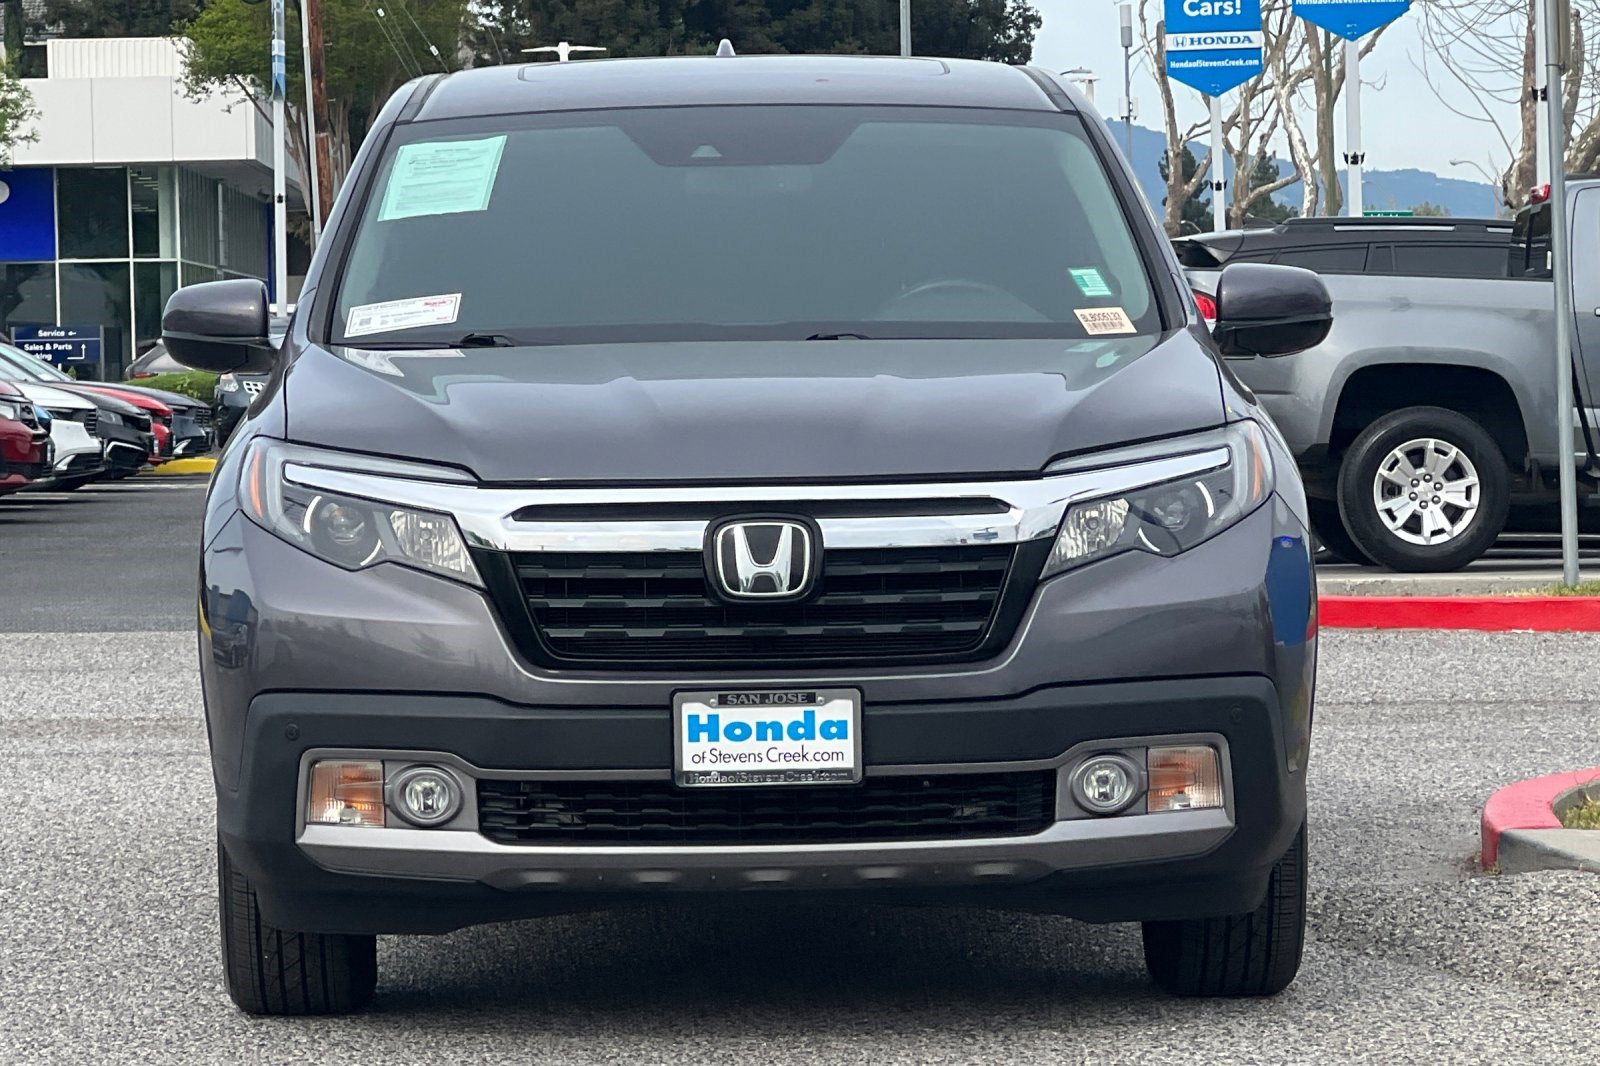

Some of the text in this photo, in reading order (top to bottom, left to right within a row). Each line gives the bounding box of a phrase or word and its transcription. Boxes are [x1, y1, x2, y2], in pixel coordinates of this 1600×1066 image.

[1183, 0, 1241, 17] Cars!
[1189, 35, 1254, 46] HONDA
[1170, 58, 1260, 69] HondaofStevensCreek.com
[24, 343, 44, 351] Sales
[45, 342, 52, 350] &
[727, 692, 808, 705] SAN JOSE
[687, 710, 849, 743] Honda
